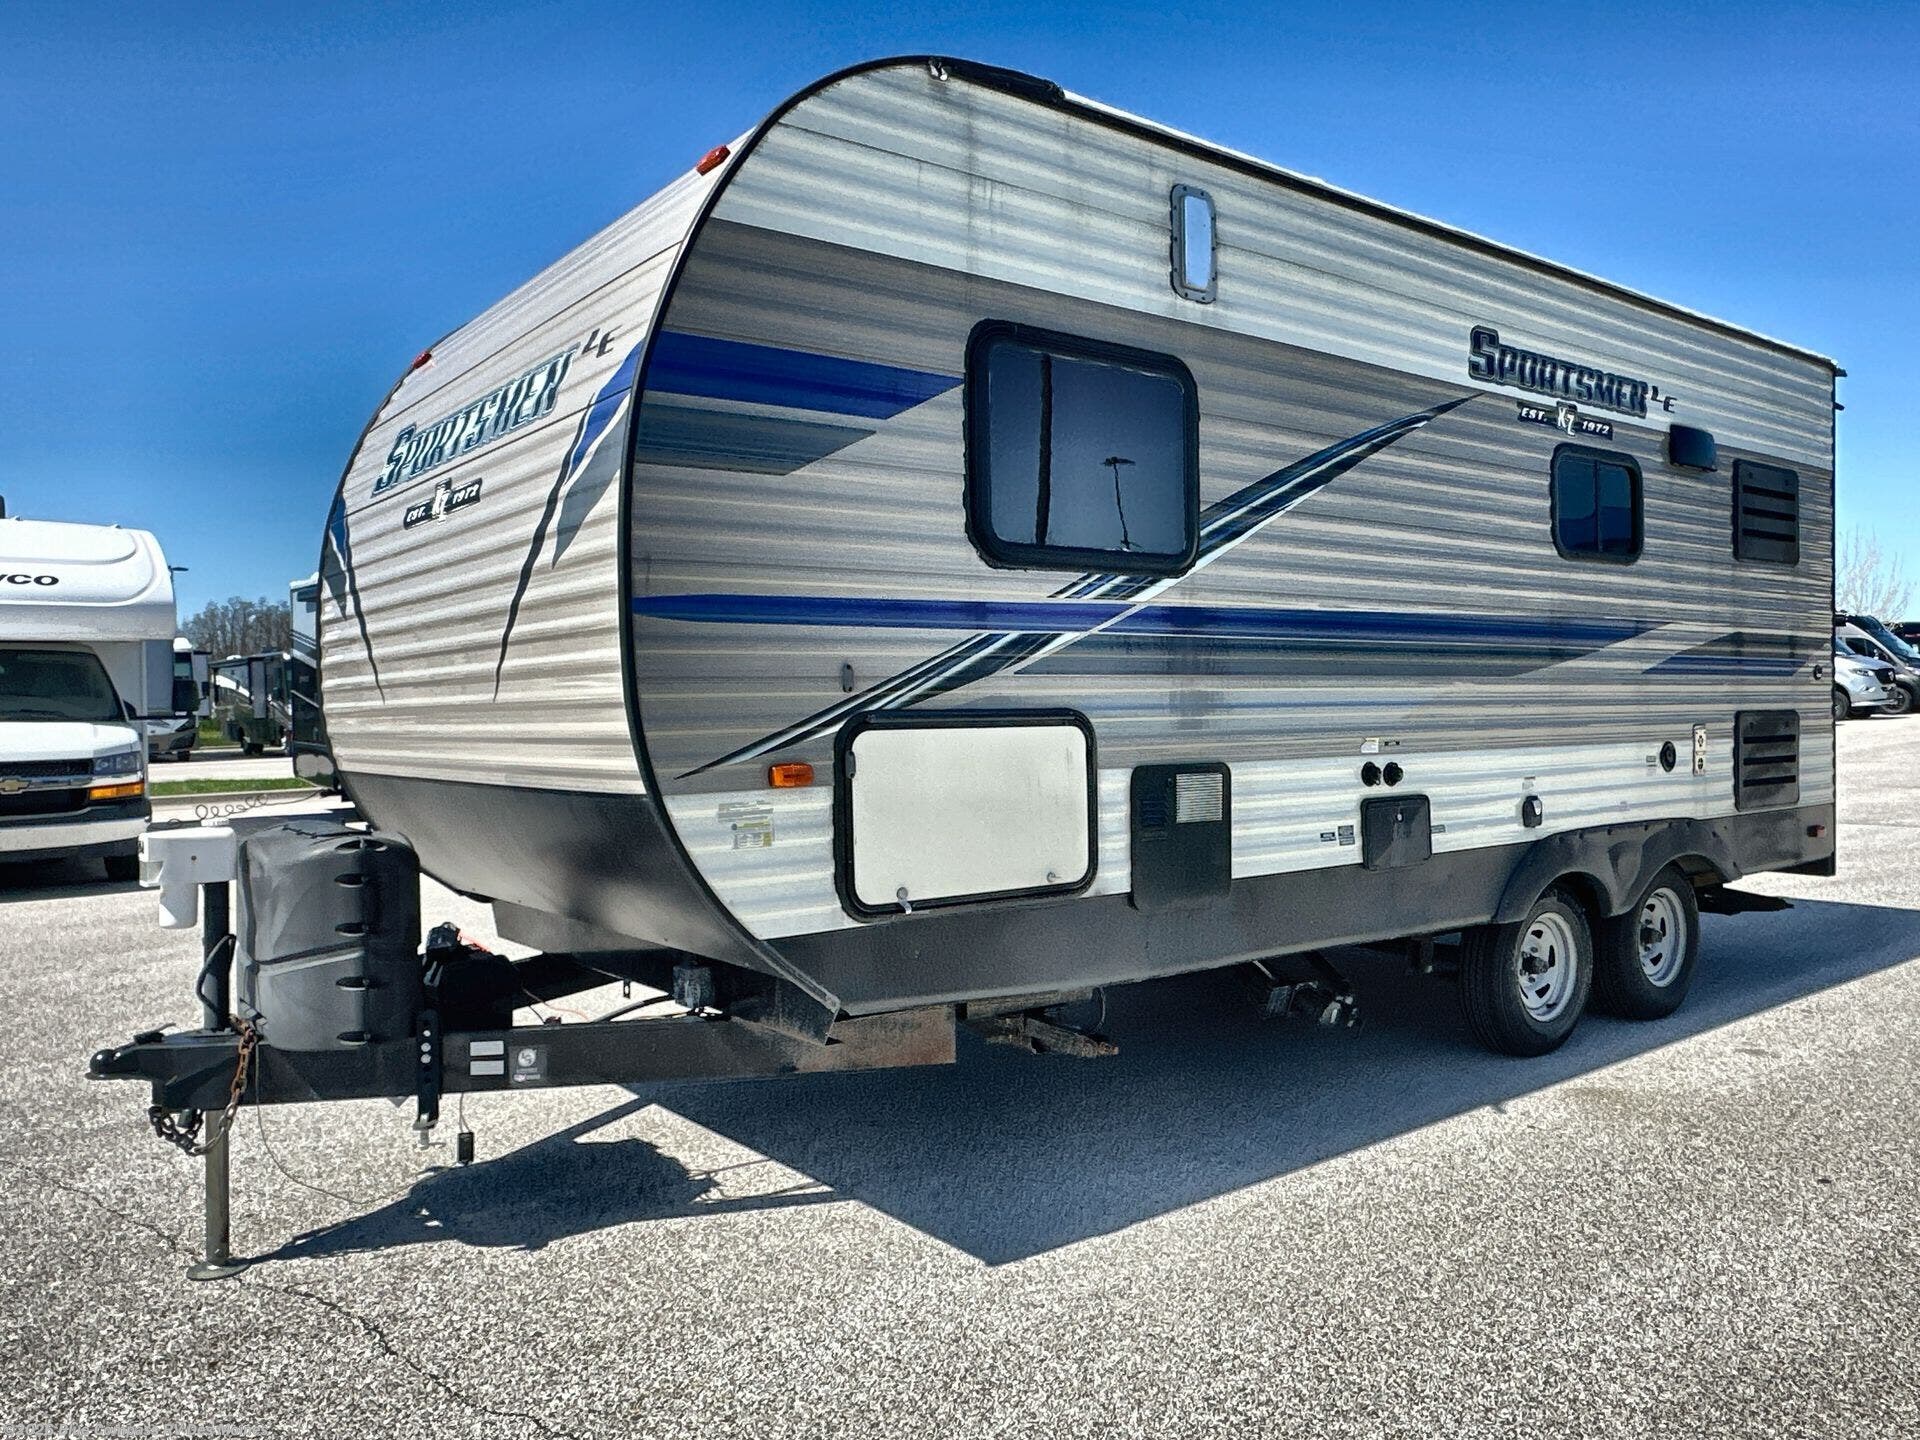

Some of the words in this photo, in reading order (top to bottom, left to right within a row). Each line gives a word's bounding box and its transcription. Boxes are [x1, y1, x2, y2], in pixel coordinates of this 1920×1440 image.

[370, 342, 581, 498] SPORTSMEN
[581, 327, 617, 358] LE
[1468, 324, 1649, 418] SPORTSMEN
[1651, 386, 1677, 413] LE
[1521, 407, 1547, 422] EST.
[1582, 420, 1610, 435] 1972
